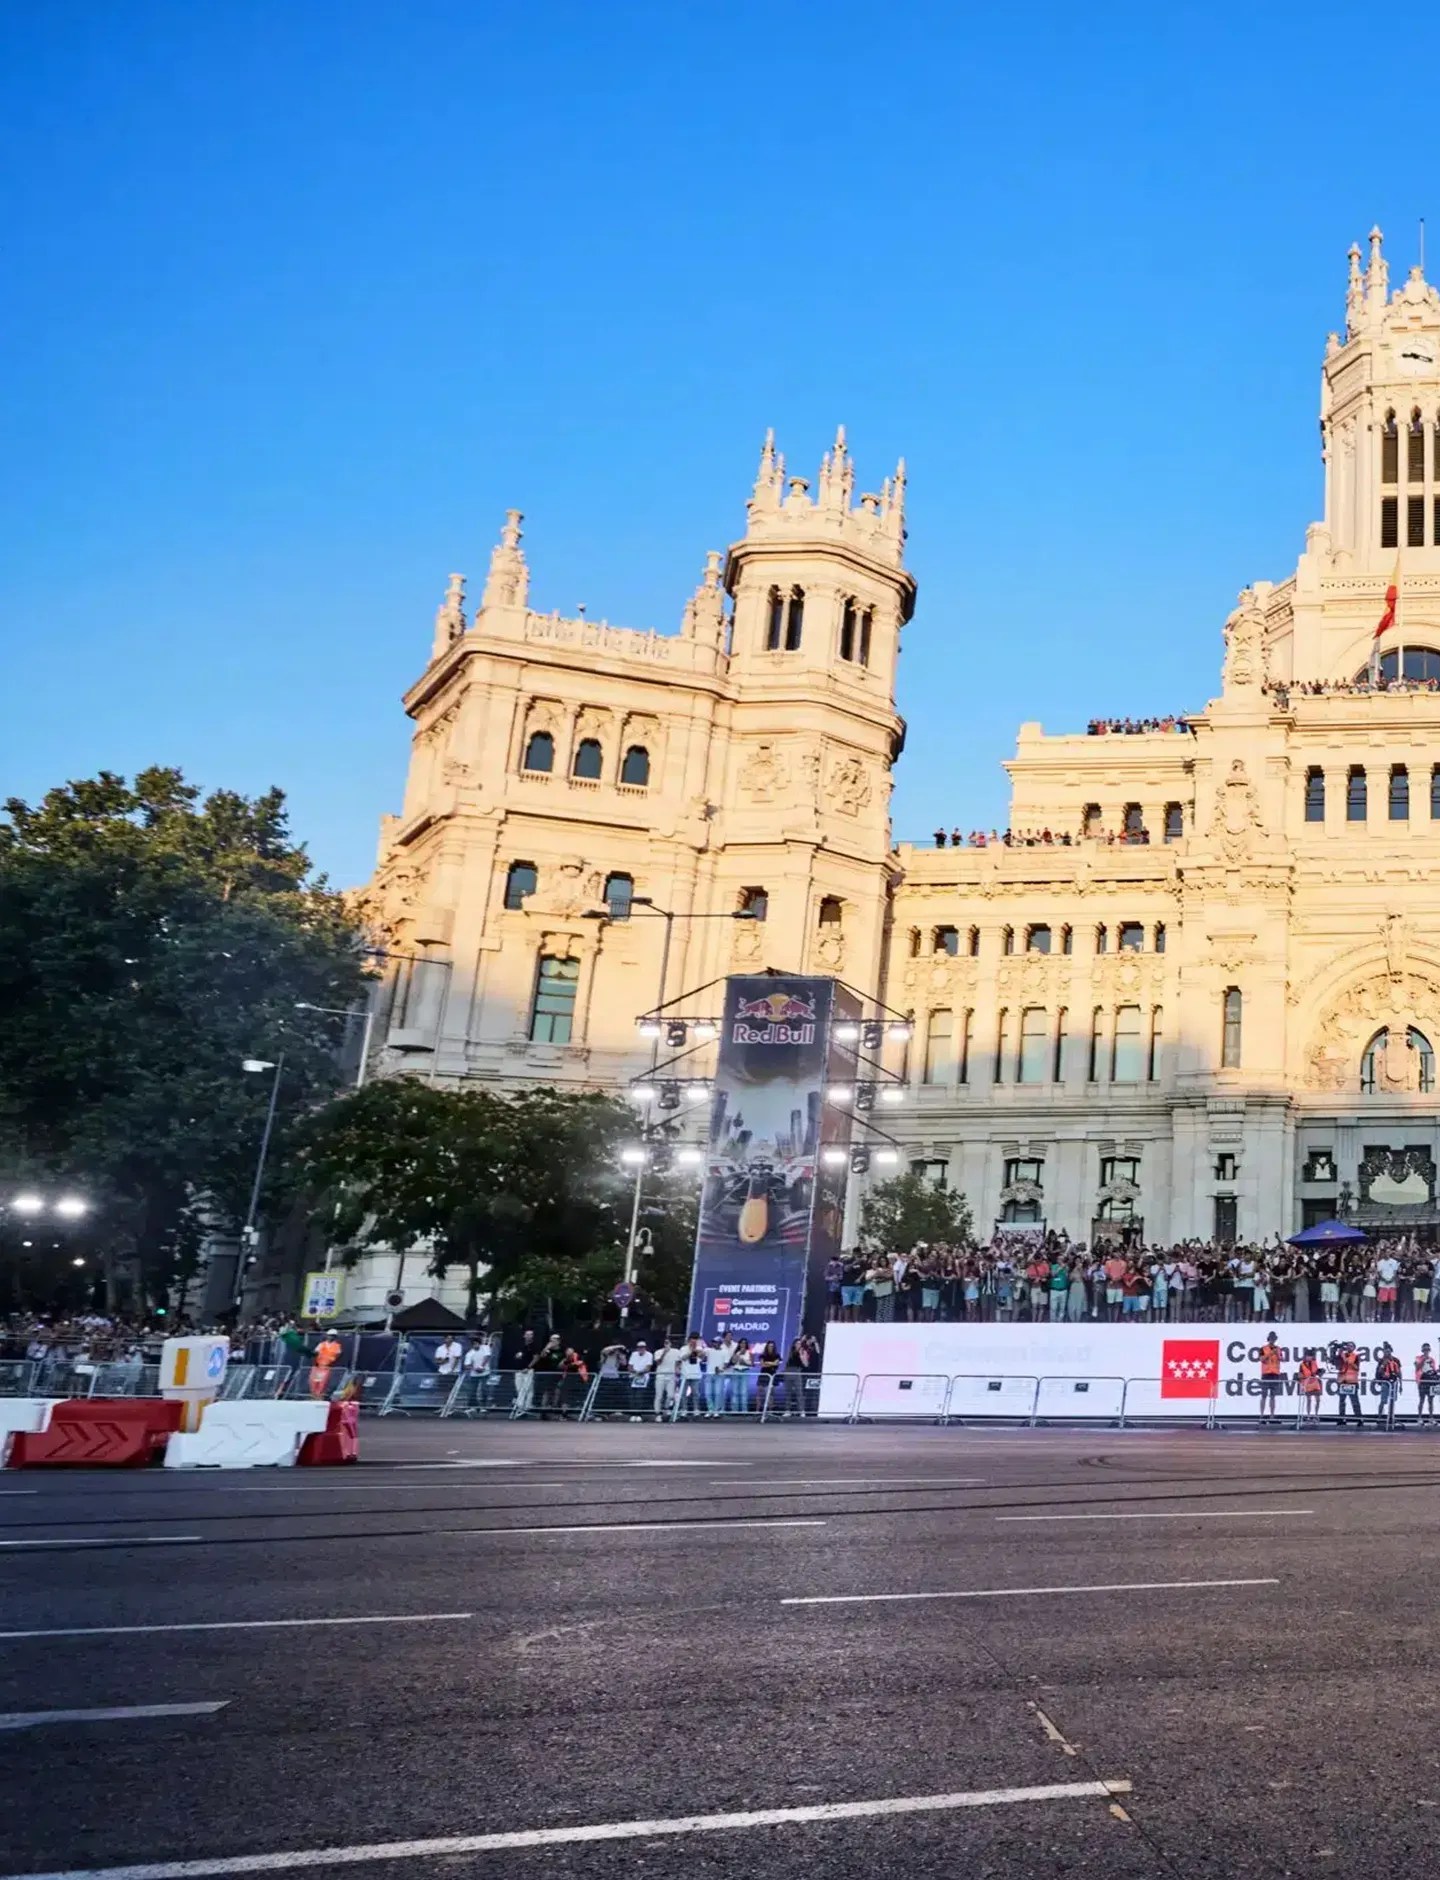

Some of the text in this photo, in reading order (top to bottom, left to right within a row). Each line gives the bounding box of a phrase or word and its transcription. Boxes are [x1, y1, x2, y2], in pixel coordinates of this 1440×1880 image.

[719, 1285, 777, 1293] EVENT PARTNERS
[730, 1322, 769, 1331] MADRID
[1225, 1373, 1262, 1396] de
